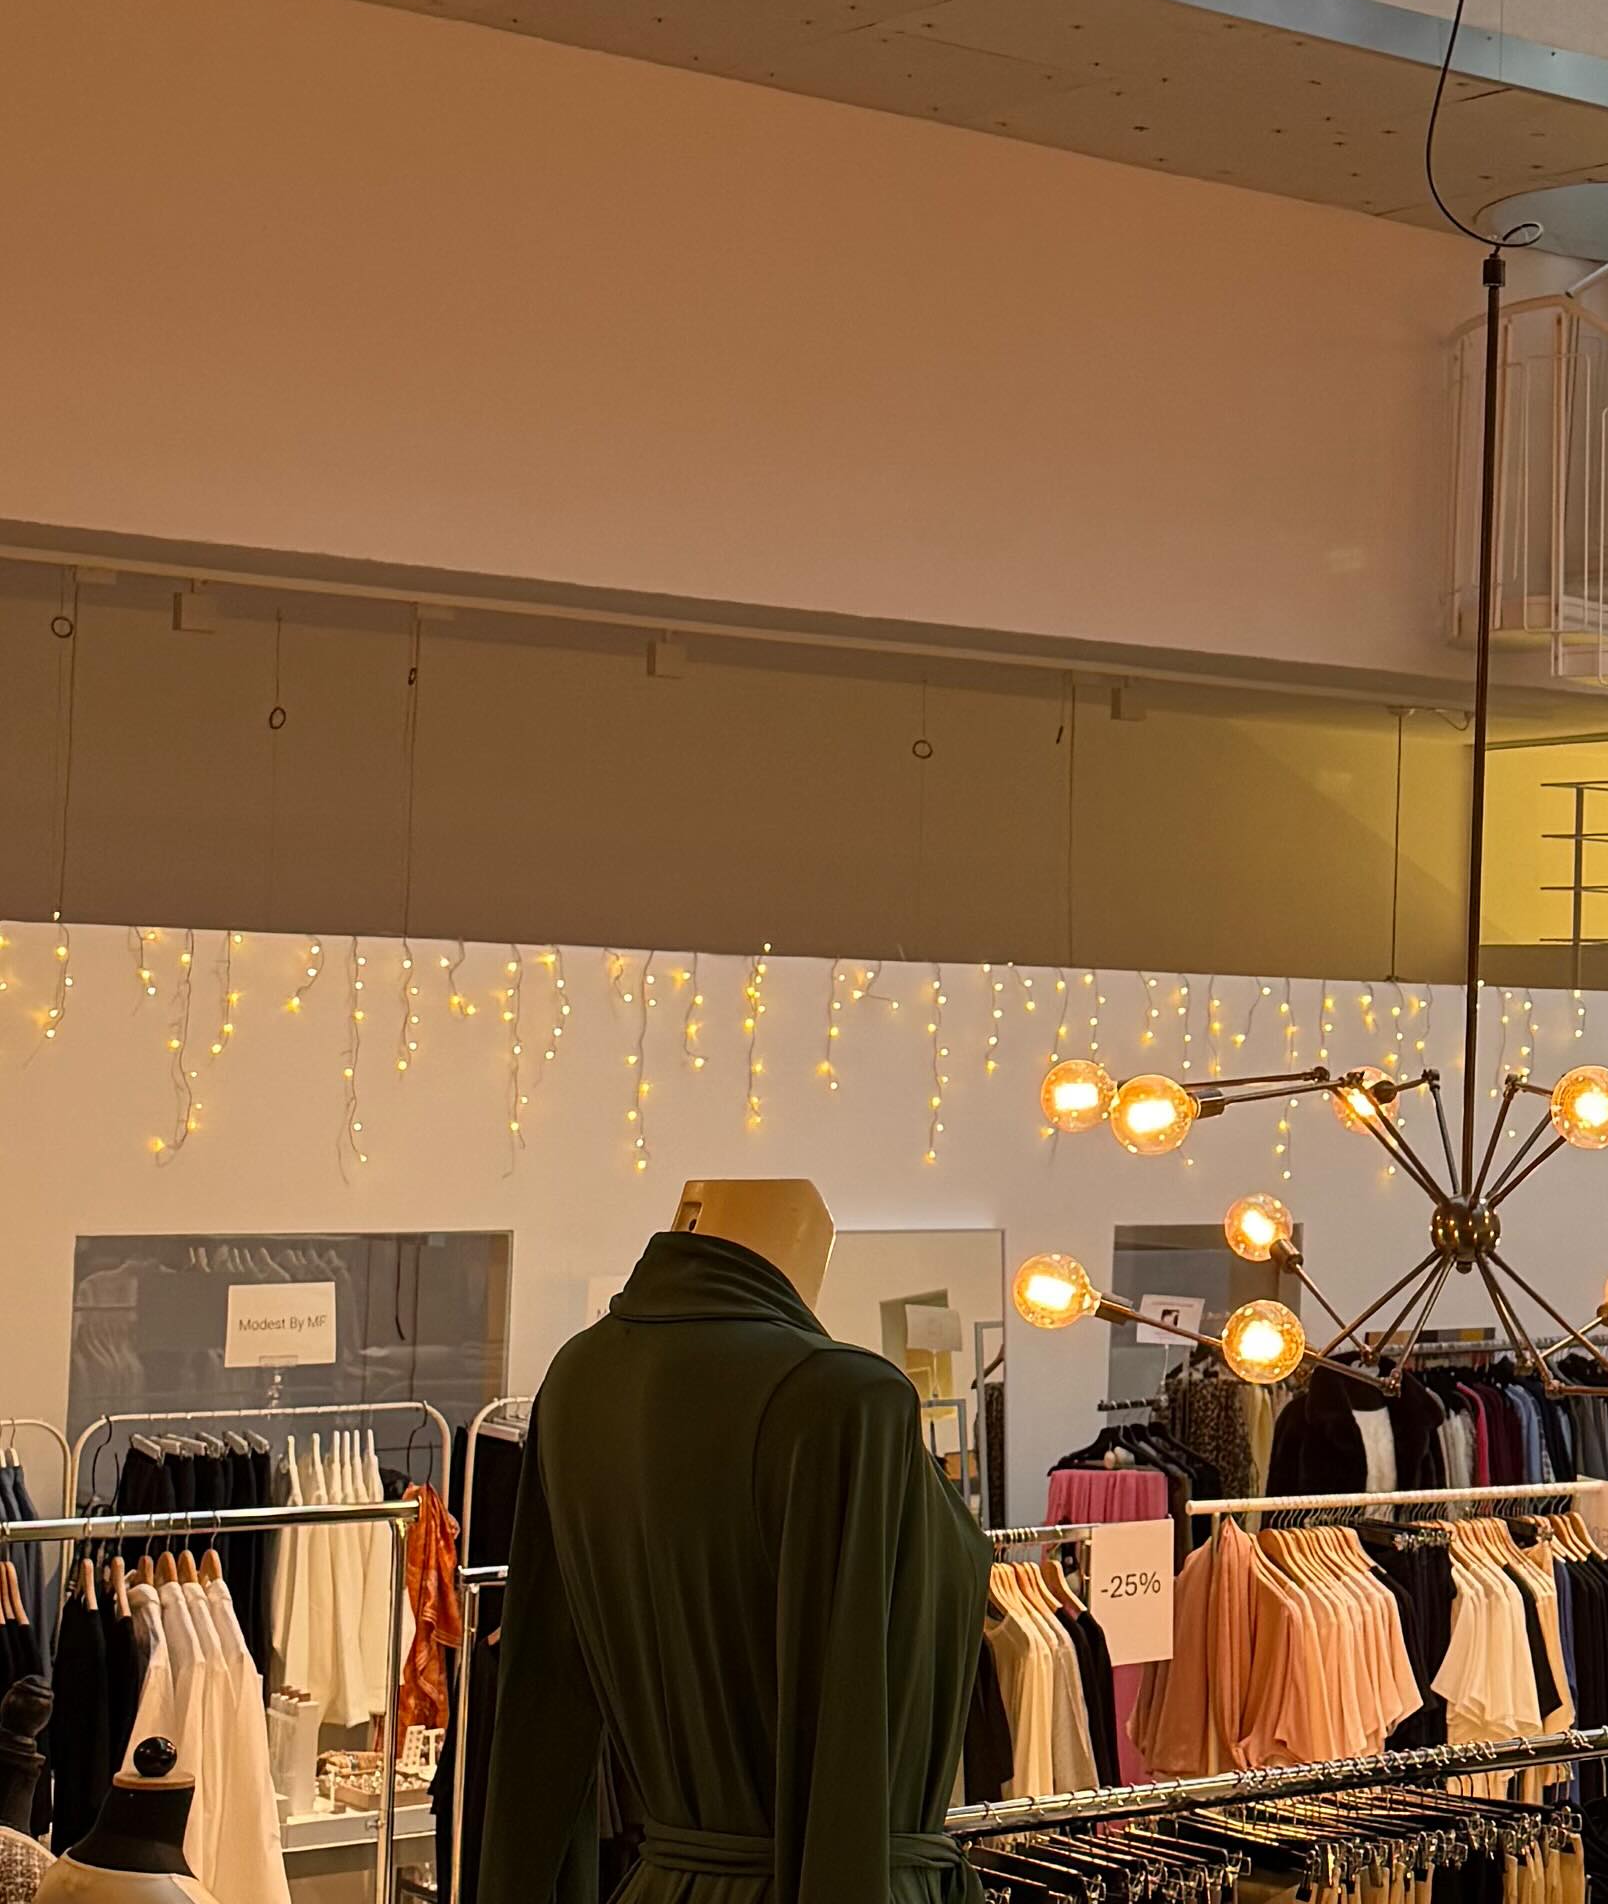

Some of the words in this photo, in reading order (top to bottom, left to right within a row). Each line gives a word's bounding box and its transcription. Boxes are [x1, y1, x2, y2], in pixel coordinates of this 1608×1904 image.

[239, 1318, 285, 1331] Modest
[290, 1317, 304, 1332] By
[1101, 1571, 1161, 1598] -25%
